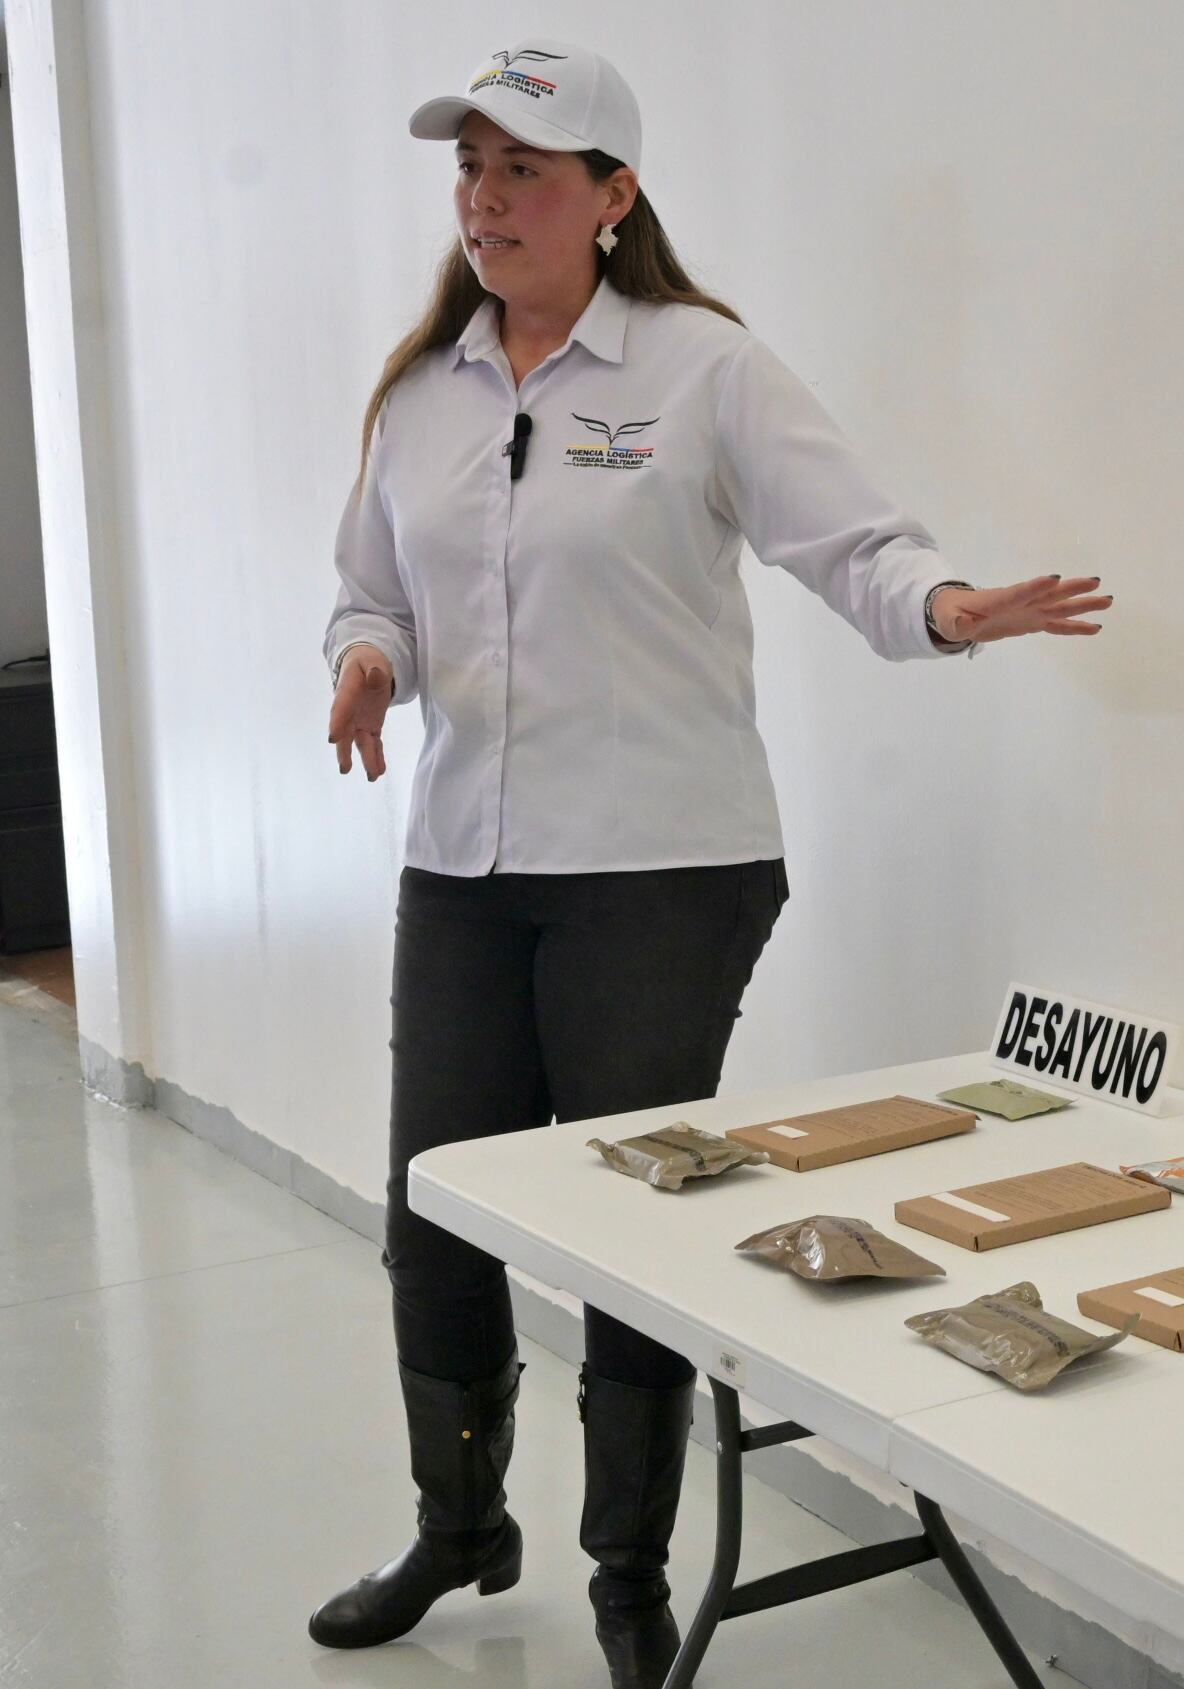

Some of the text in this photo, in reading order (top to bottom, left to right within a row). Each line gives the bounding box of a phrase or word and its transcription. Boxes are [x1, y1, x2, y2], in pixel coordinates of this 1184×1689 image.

[496, 80, 541, 99] MILITARES
[566, 449, 653, 459] AGENCIA LOGÍSTICA
[607, 458, 644, 466] MILITARES
[996, 992, 1166, 1104] DESAYUNO
